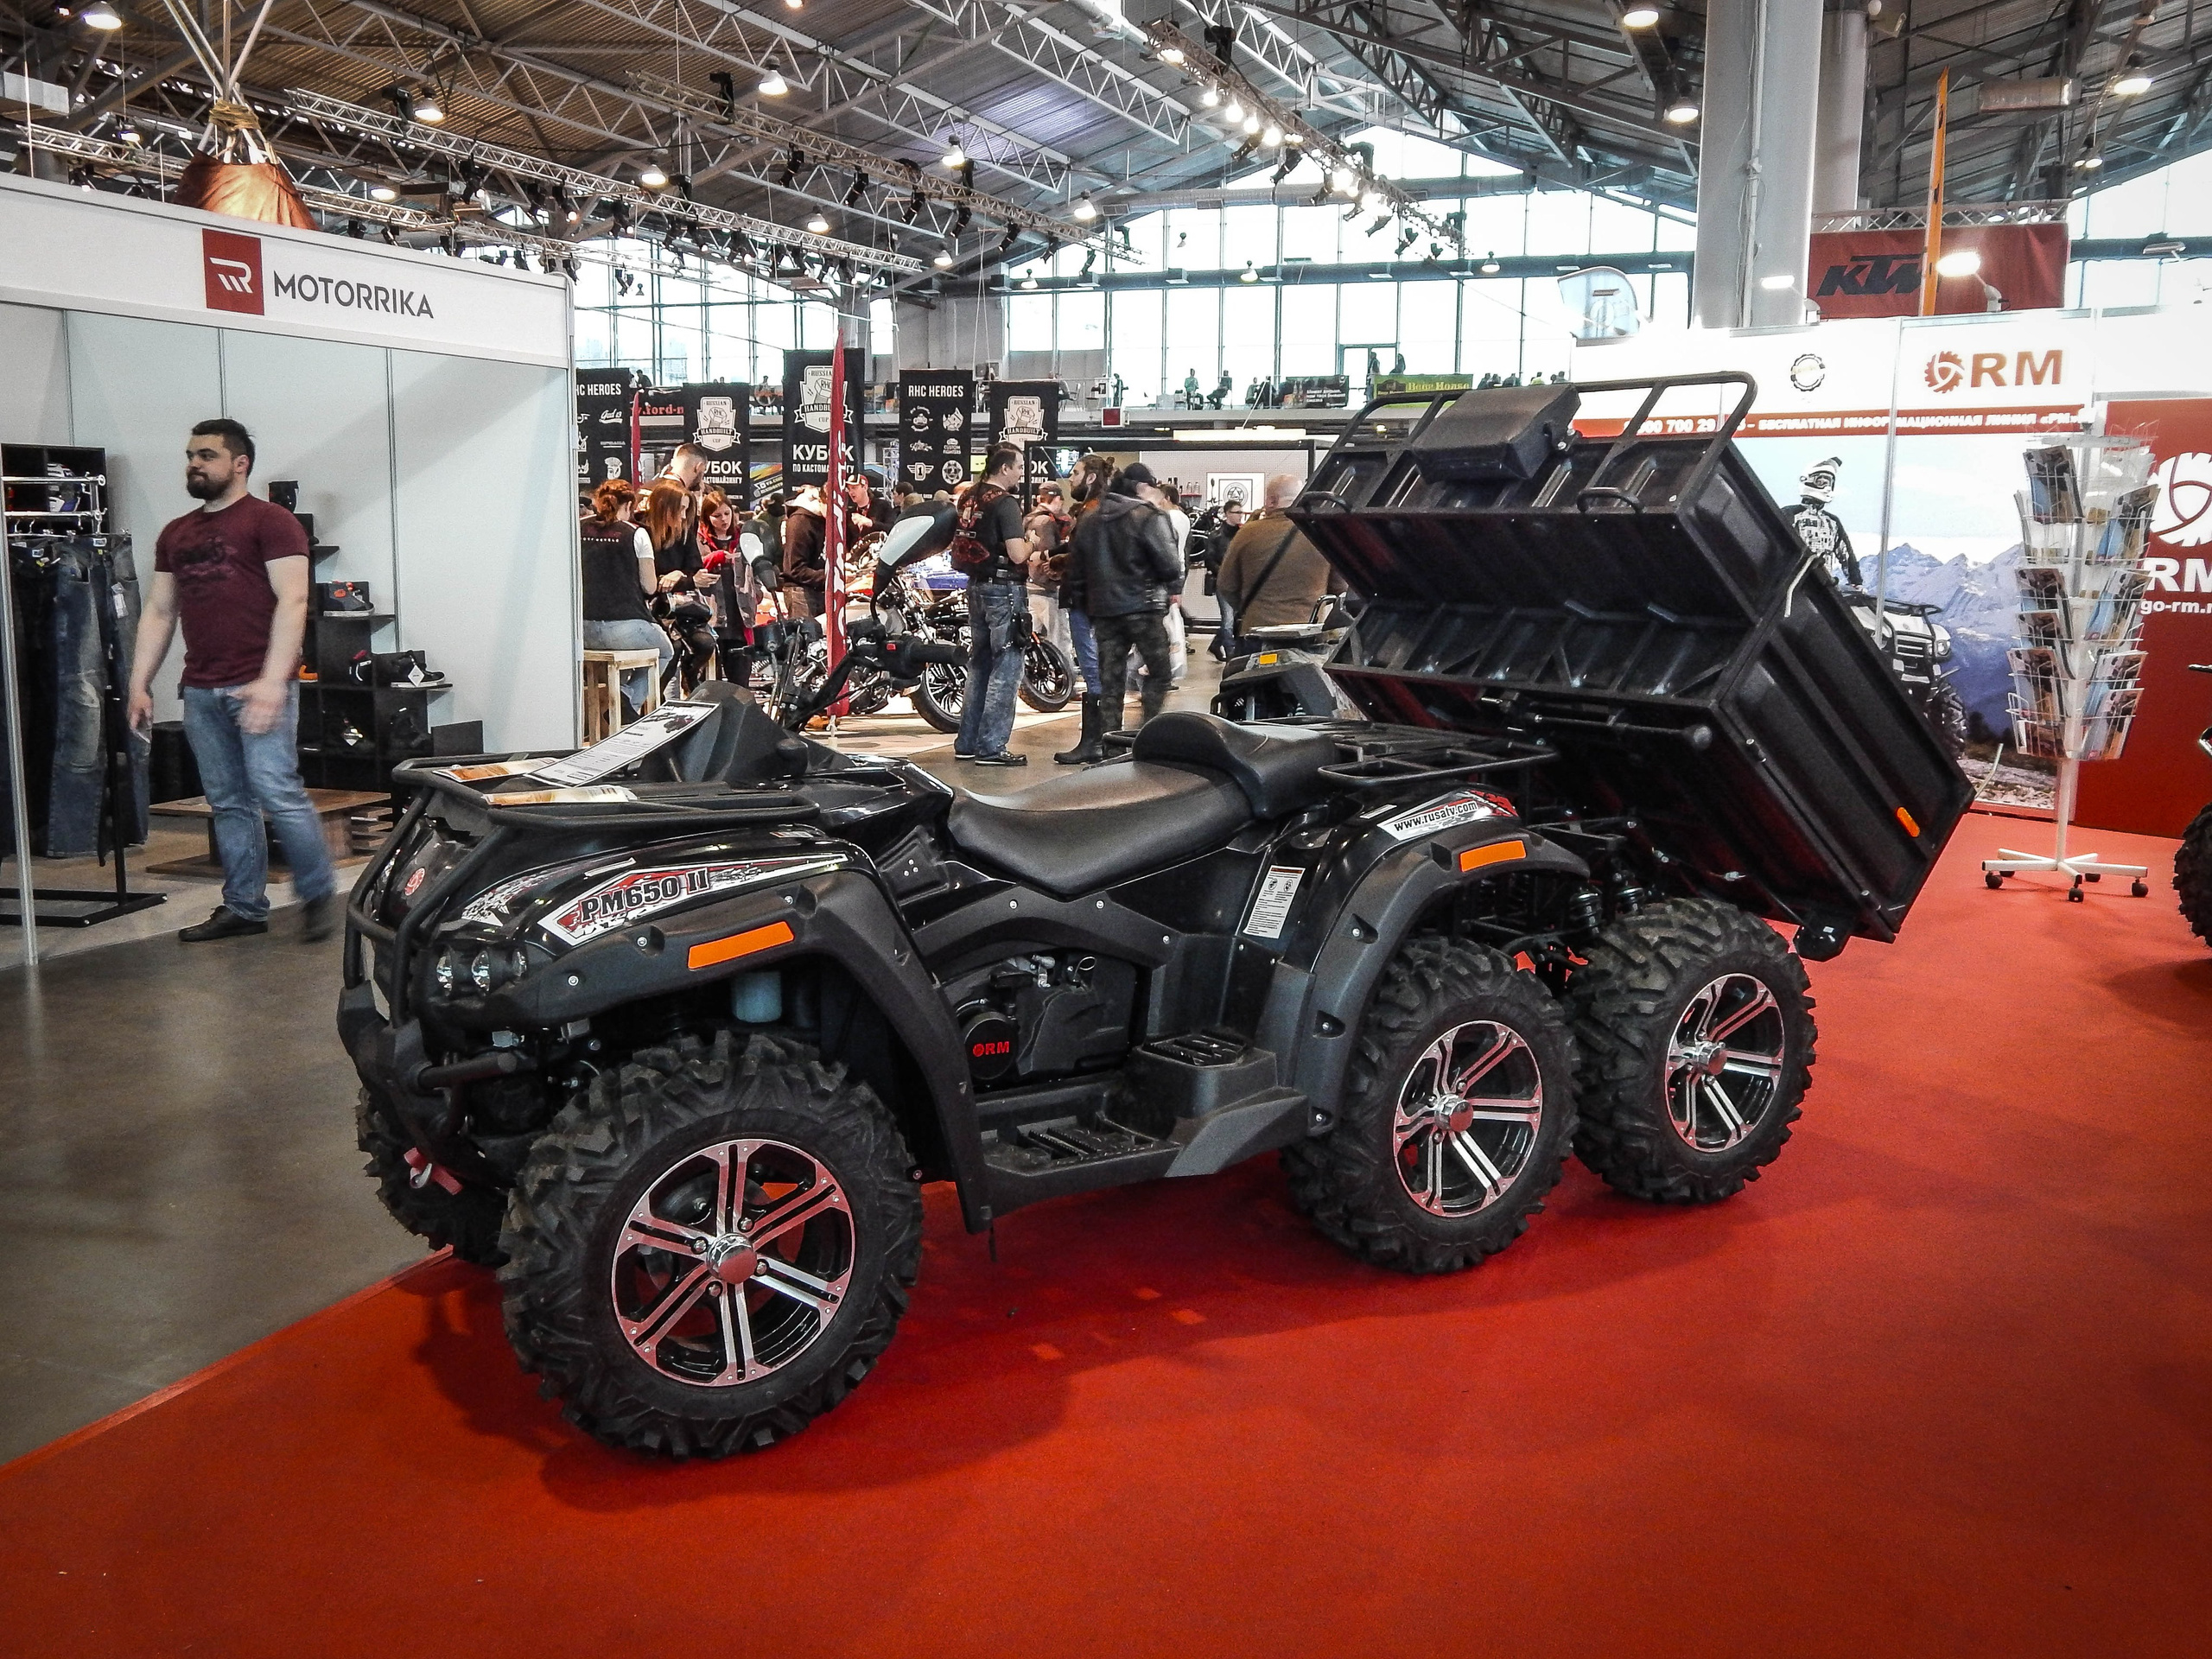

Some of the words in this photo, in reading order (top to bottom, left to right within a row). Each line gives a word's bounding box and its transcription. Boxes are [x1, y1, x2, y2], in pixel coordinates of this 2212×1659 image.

[273, 270, 435, 319] MOTORRIKA
[1970, 349, 2063, 388] RM
[576, 384, 586, 396] HC
[588, 383, 621, 396] HEROES
[908, 385, 926, 397] RHC
[928, 385, 963, 397] HEROES
[1666, 419, 1694, 433] 700
[1696, 418, 1717, 432] 29
[1758, 417, 1841, 430] БЕСПЛАТНАЯ
[792, 444, 855, 461] КУБК
[704, 461, 742, 474] УБОК
[792, 463, 801, 473] ПО
[1394, 800, 1478, 832] www.rusatv.com
[985, 1041, 1009, 1055] RM
